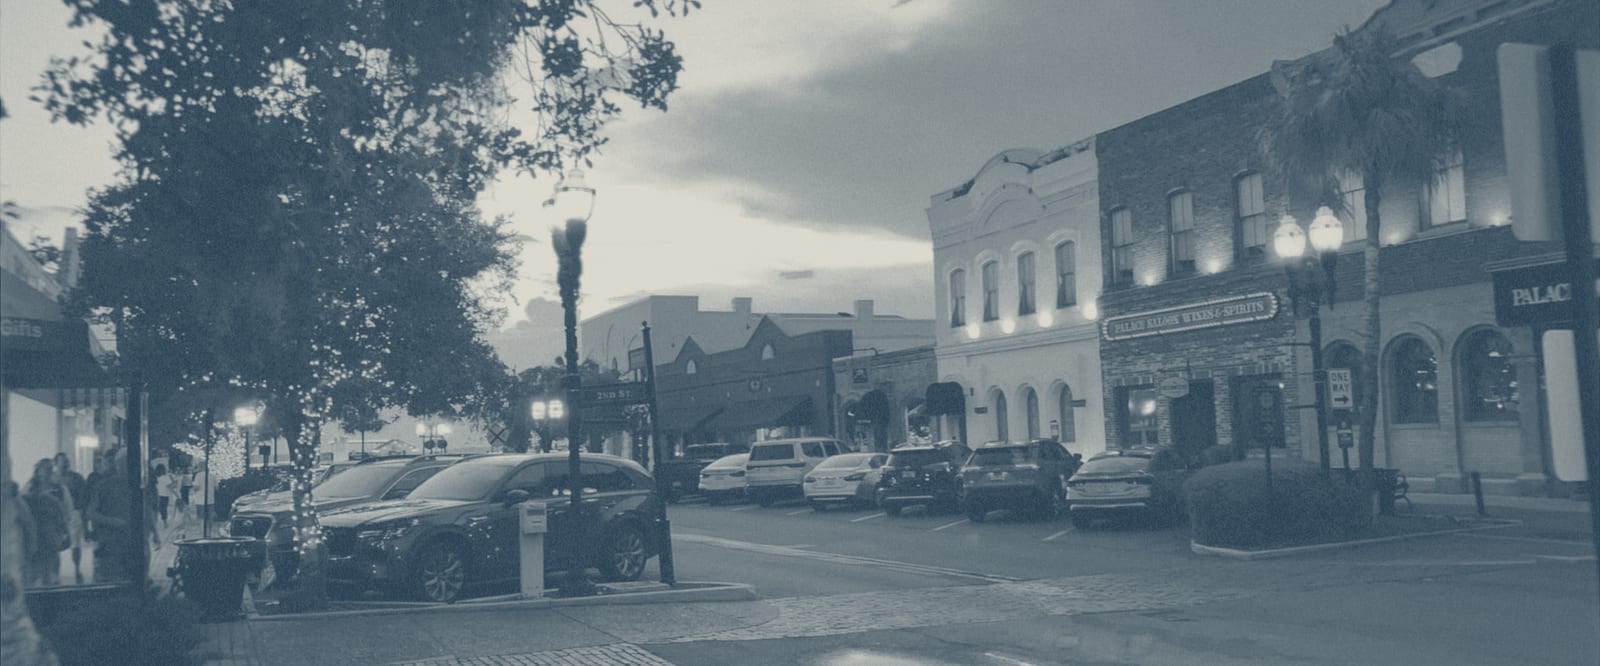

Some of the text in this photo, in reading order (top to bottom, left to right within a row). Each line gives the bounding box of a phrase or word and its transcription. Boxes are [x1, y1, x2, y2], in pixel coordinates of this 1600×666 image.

[1512, 283, 1571, 307] PALAC
[1182, 309, 1214, 323] WINES
[1223, 301, 1264, 317] SPIRITS
[1331, 372, 1348, 382] ONE
[1332, 383, 1349, 393] WAY
[597, 391, 616, 400] 2ND
